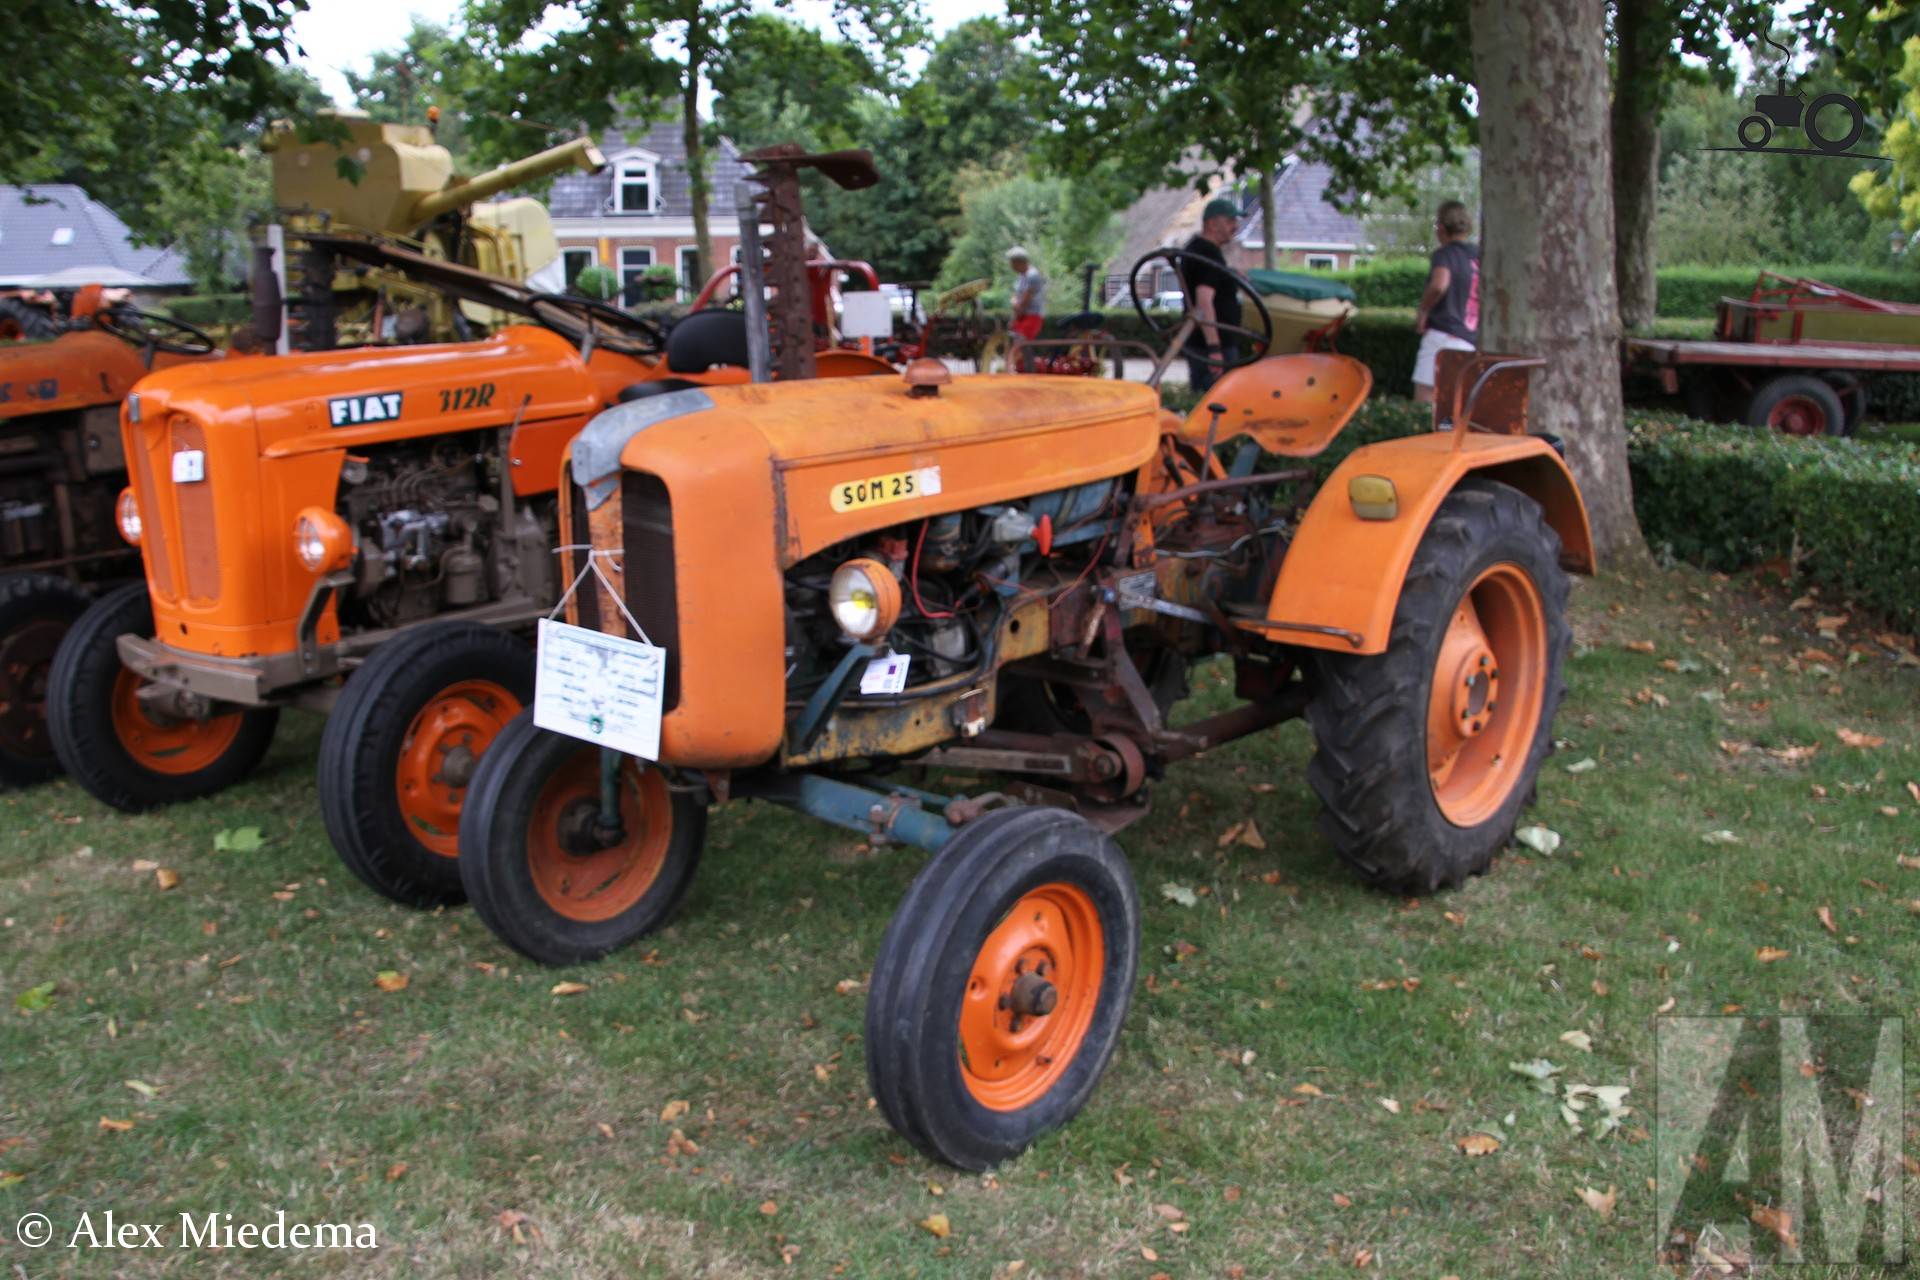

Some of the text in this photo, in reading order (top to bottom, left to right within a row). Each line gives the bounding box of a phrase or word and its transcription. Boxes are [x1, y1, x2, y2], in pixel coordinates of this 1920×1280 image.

[330, 394, 401, 425] FIAT
[843, 475, 914, 505] SOM 25
